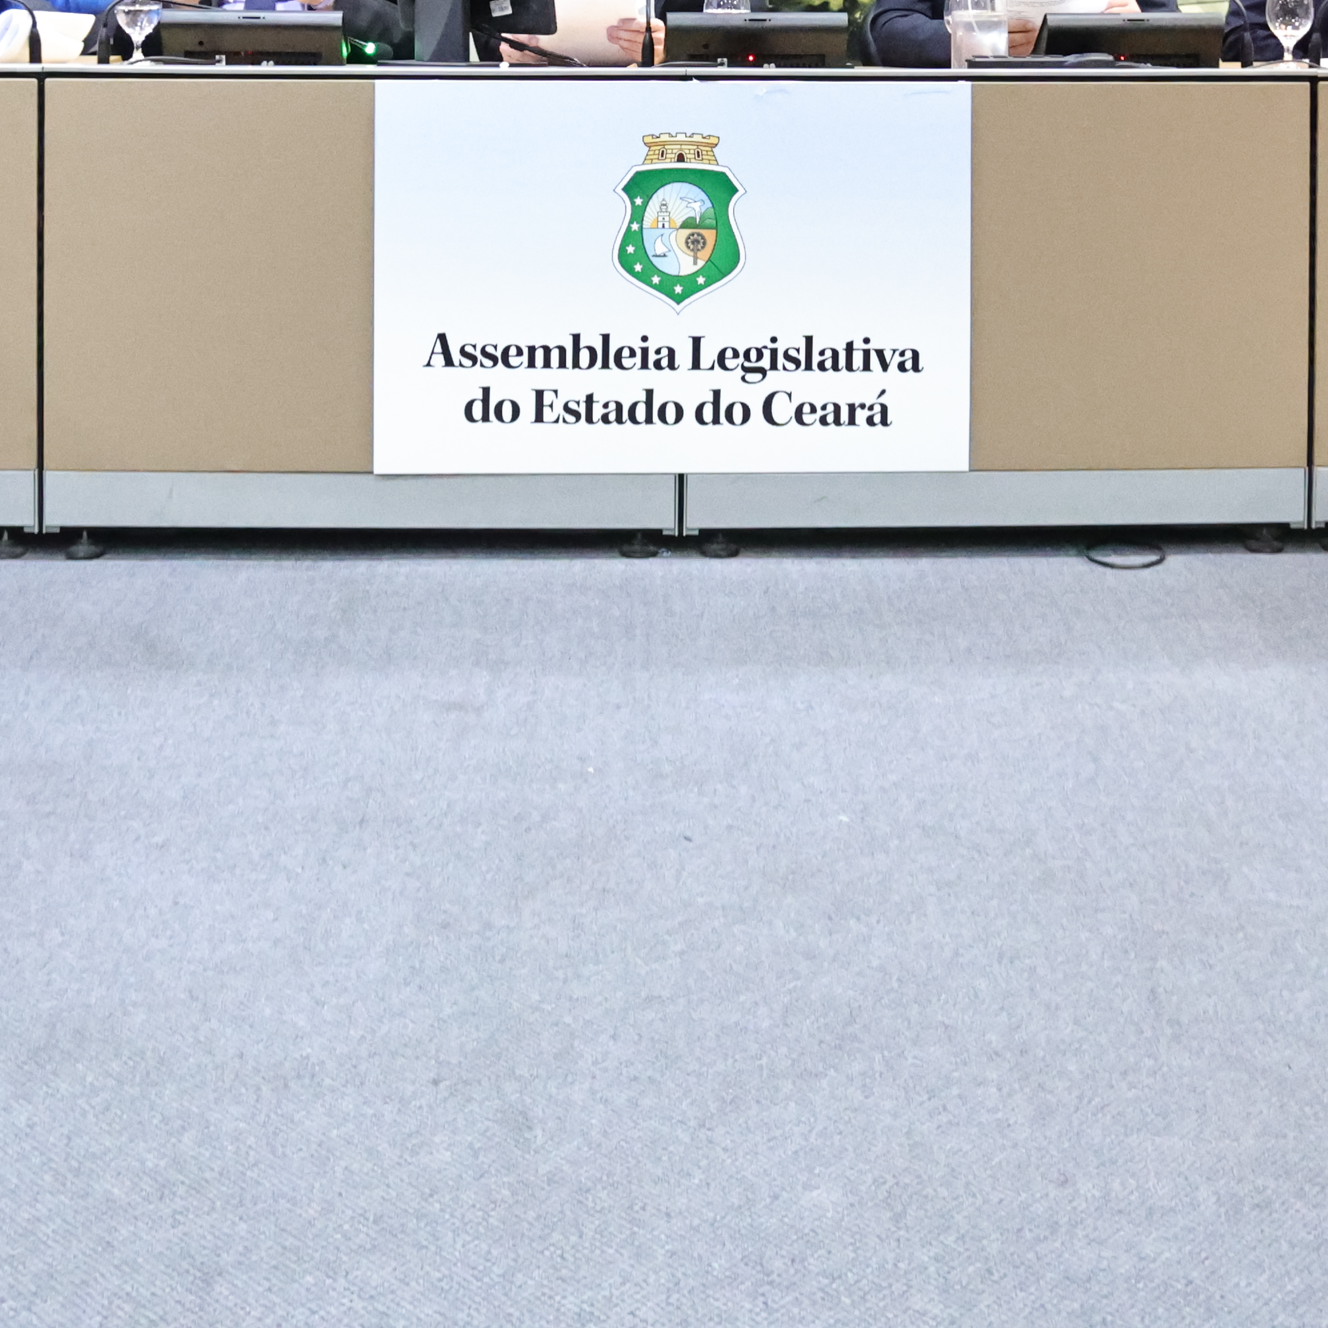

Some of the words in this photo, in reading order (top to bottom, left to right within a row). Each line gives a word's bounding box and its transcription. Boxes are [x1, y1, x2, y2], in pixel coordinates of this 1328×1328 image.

[423, 332, 680, 371] Assembleia
[687, 334, 925, 385] Legislativa
[463, 386, 521, 424] do
[531, 388, 684, 426] Estado
[694, 388, 751, 426] do
[761, 388, 893, 427] Ceará
